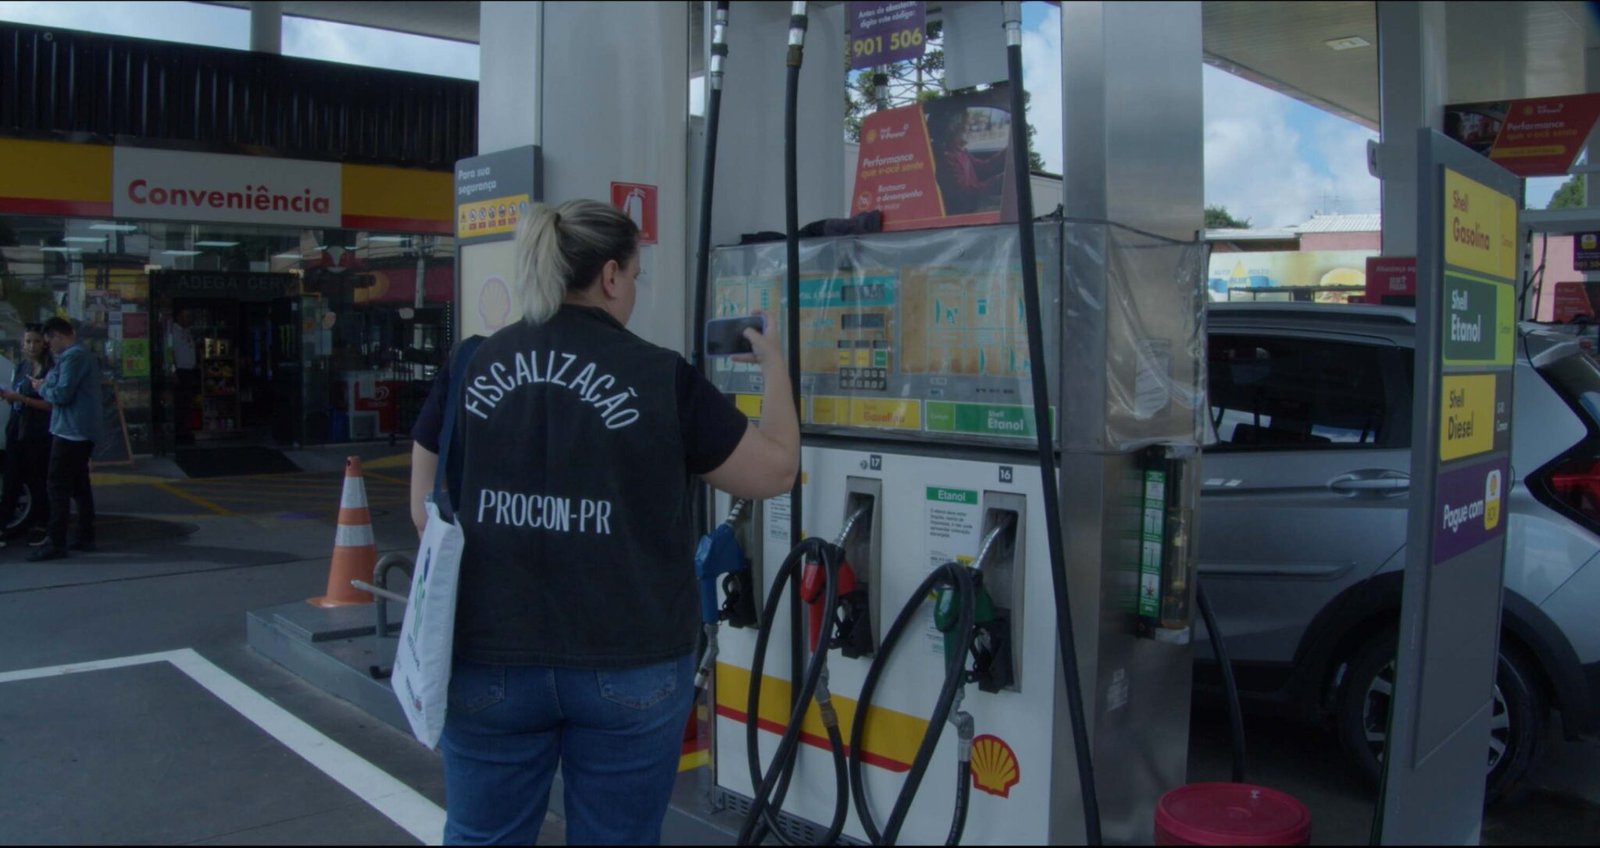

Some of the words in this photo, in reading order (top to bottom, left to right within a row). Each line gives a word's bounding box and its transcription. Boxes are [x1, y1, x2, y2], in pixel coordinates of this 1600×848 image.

[854, 35, 882, 57] 901
[889, 27, 923, 51] 506
[1507, 121, 1564, 131] Performance
[863, 154, 914, 167] Performance
[458, 170, 476, 180] Para
[477, 167, 491, 177] sua
[128, 179, 329, 214] Conveniência
[458, 180, 497, 196] segurança
[1453, 190, 1468, 213] Shell
[1453, 216, 1490, 251] Gasolina
[177, 275, 238, 289] ADEGA
[1452, 289, 1468, 311] Shell
[1451, 314, 1481, 342] Etanol
[465, 350, 639, 429] FISCALIZAÇÃO
[1449, 388, 1464, 409] Shell
[988, 410, 1004, 418] Shell
[988, 418, 1024, 431] Etanol
[1448, 411, 1474, 440] Diesel
[871, 458, 880, 468] 17
[1000, 469, 1011, 481] 16
[937, 489, 966, 502] Etanol
[477, 489, 611, 534] PROCON-PR
[1443, 503, 1467, 534] Pague
[1468, 500, 1484, 519] com
